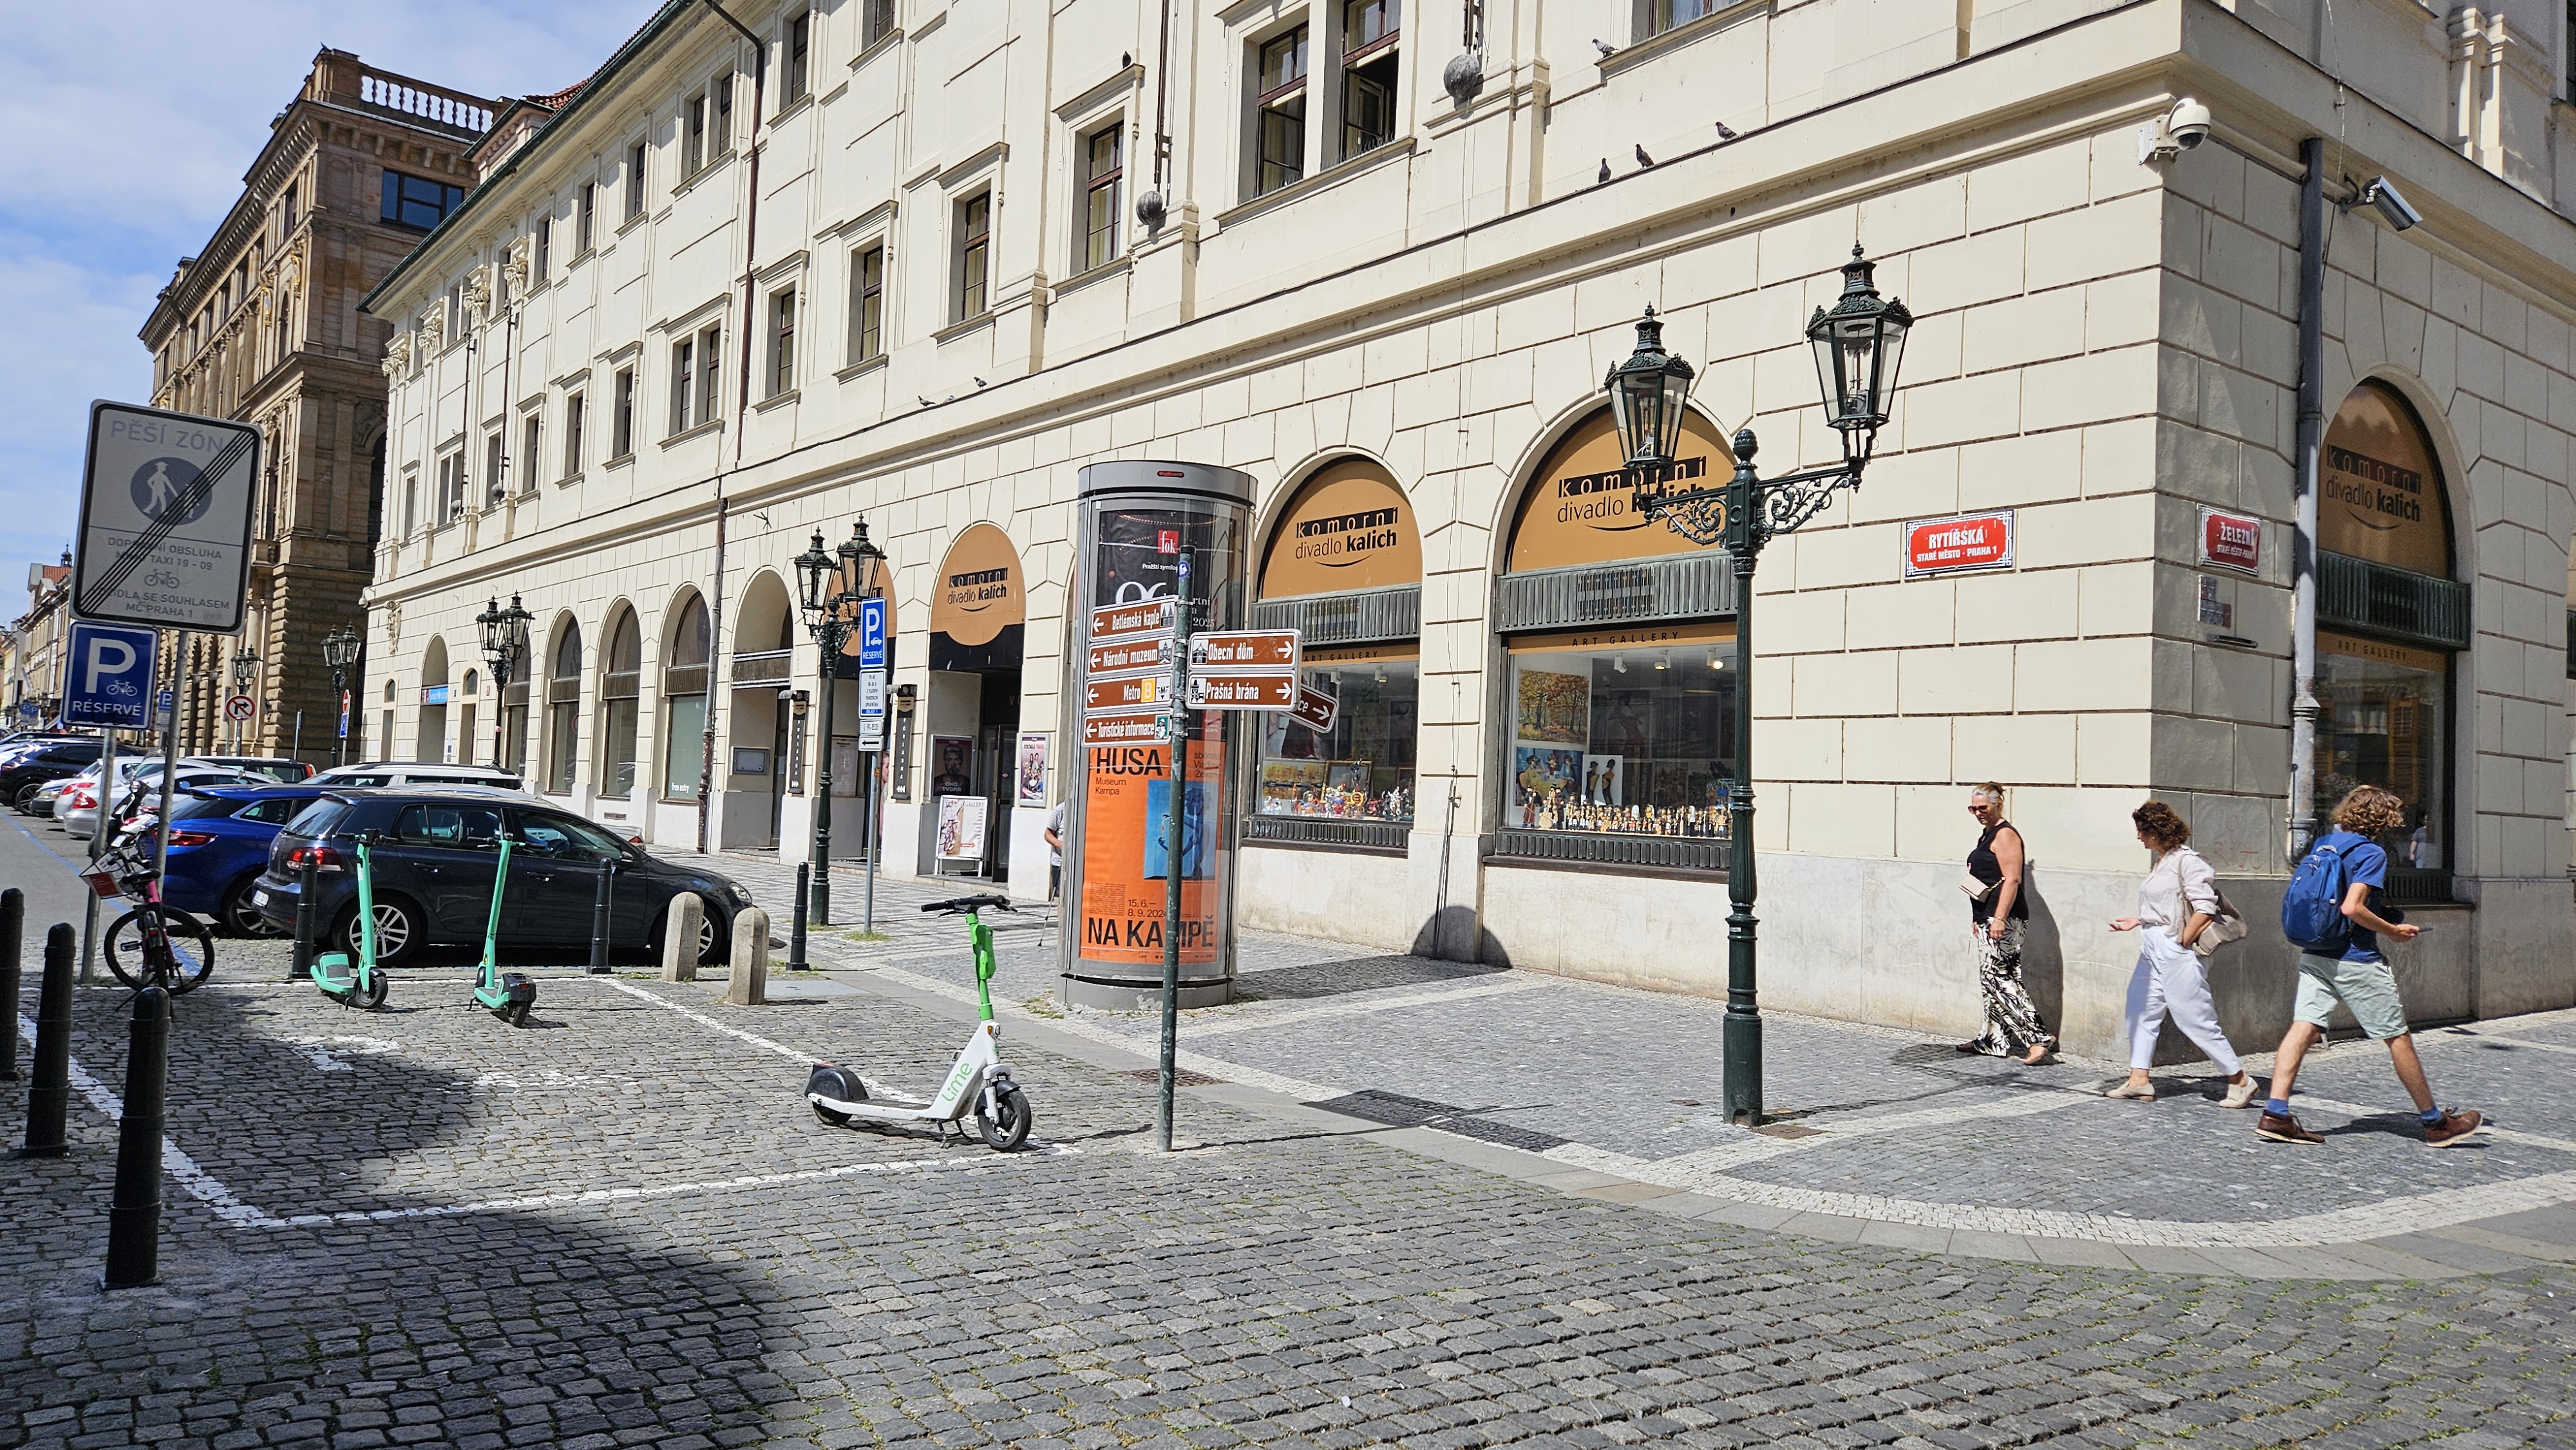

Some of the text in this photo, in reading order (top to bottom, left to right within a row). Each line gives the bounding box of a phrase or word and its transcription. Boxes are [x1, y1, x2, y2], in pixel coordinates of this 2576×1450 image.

[110, 419, 167, 445] PĚŠÍ
[2327, 444, 2421, 495] komorní
[2327, 474, 2420, 522] divadlo kalich
[1557, 496, 1624, 523] divadlo
[1296, 507, 1399, 538] komorní
[1160, 531, 1176, 554] fok
[1296, 529, 1397, 560] divadlo kalich
[1928, 525, 1984, 549] RYTÍŘSKÁ
[169, 545, 222, 559] OBSLUHA
[1917, 550, 1937, 562] STARÉ
[1938, 549, 1961, 560] MĚSTO
[1967, 547, 1991, 557] PRAHA
[1993, 546, 1997, 554] 1
[151, 555, 173, 565] TAXI
[177, 558, 189, 567] 19
[200, 561, 213, 570] 09
[949, 567, 1009, 588] komorní
[143, 592, 157, 601] SE
[160, 594, 230, 609] SOUHLASEM
[947, 583, 1007, 604] divadlo kalich
[126, 600, 143, 612] MČ
[146, 605, 185, 616] PRAHA
[866, 608, 880, 646] P
[1112, 608, 1160, 630] Betlémská kaple
[1572, 632, 1678, 646] ART GALLERY
[863, 648, 882, 659] RÉSERVÉ
[1103, 648, 1158, 667] Národní muzeum
[1208, 642, 1254, 661] Obecní dům
[1330, 651, 1378, 661] GALLERY
[2338, 640, 2407, 661] ART GALLERY
[86, 637, 136, 693] P
[1123, 684, 1141, 701] Metro
[1144, 682, 1152, 700] B
[1206, 681, 1259, 700] Prašná brána
[1098, 720, 1155, 738] Turistické informace
[1097, 748, 1162, 777] HUSA
[1095, 786, 1120, 796] Kampa
[1096, 777, 1126, 786] Museum
[1128, 909, 1135, 917] 8.
[1088, 917, 1119, 946] NA
